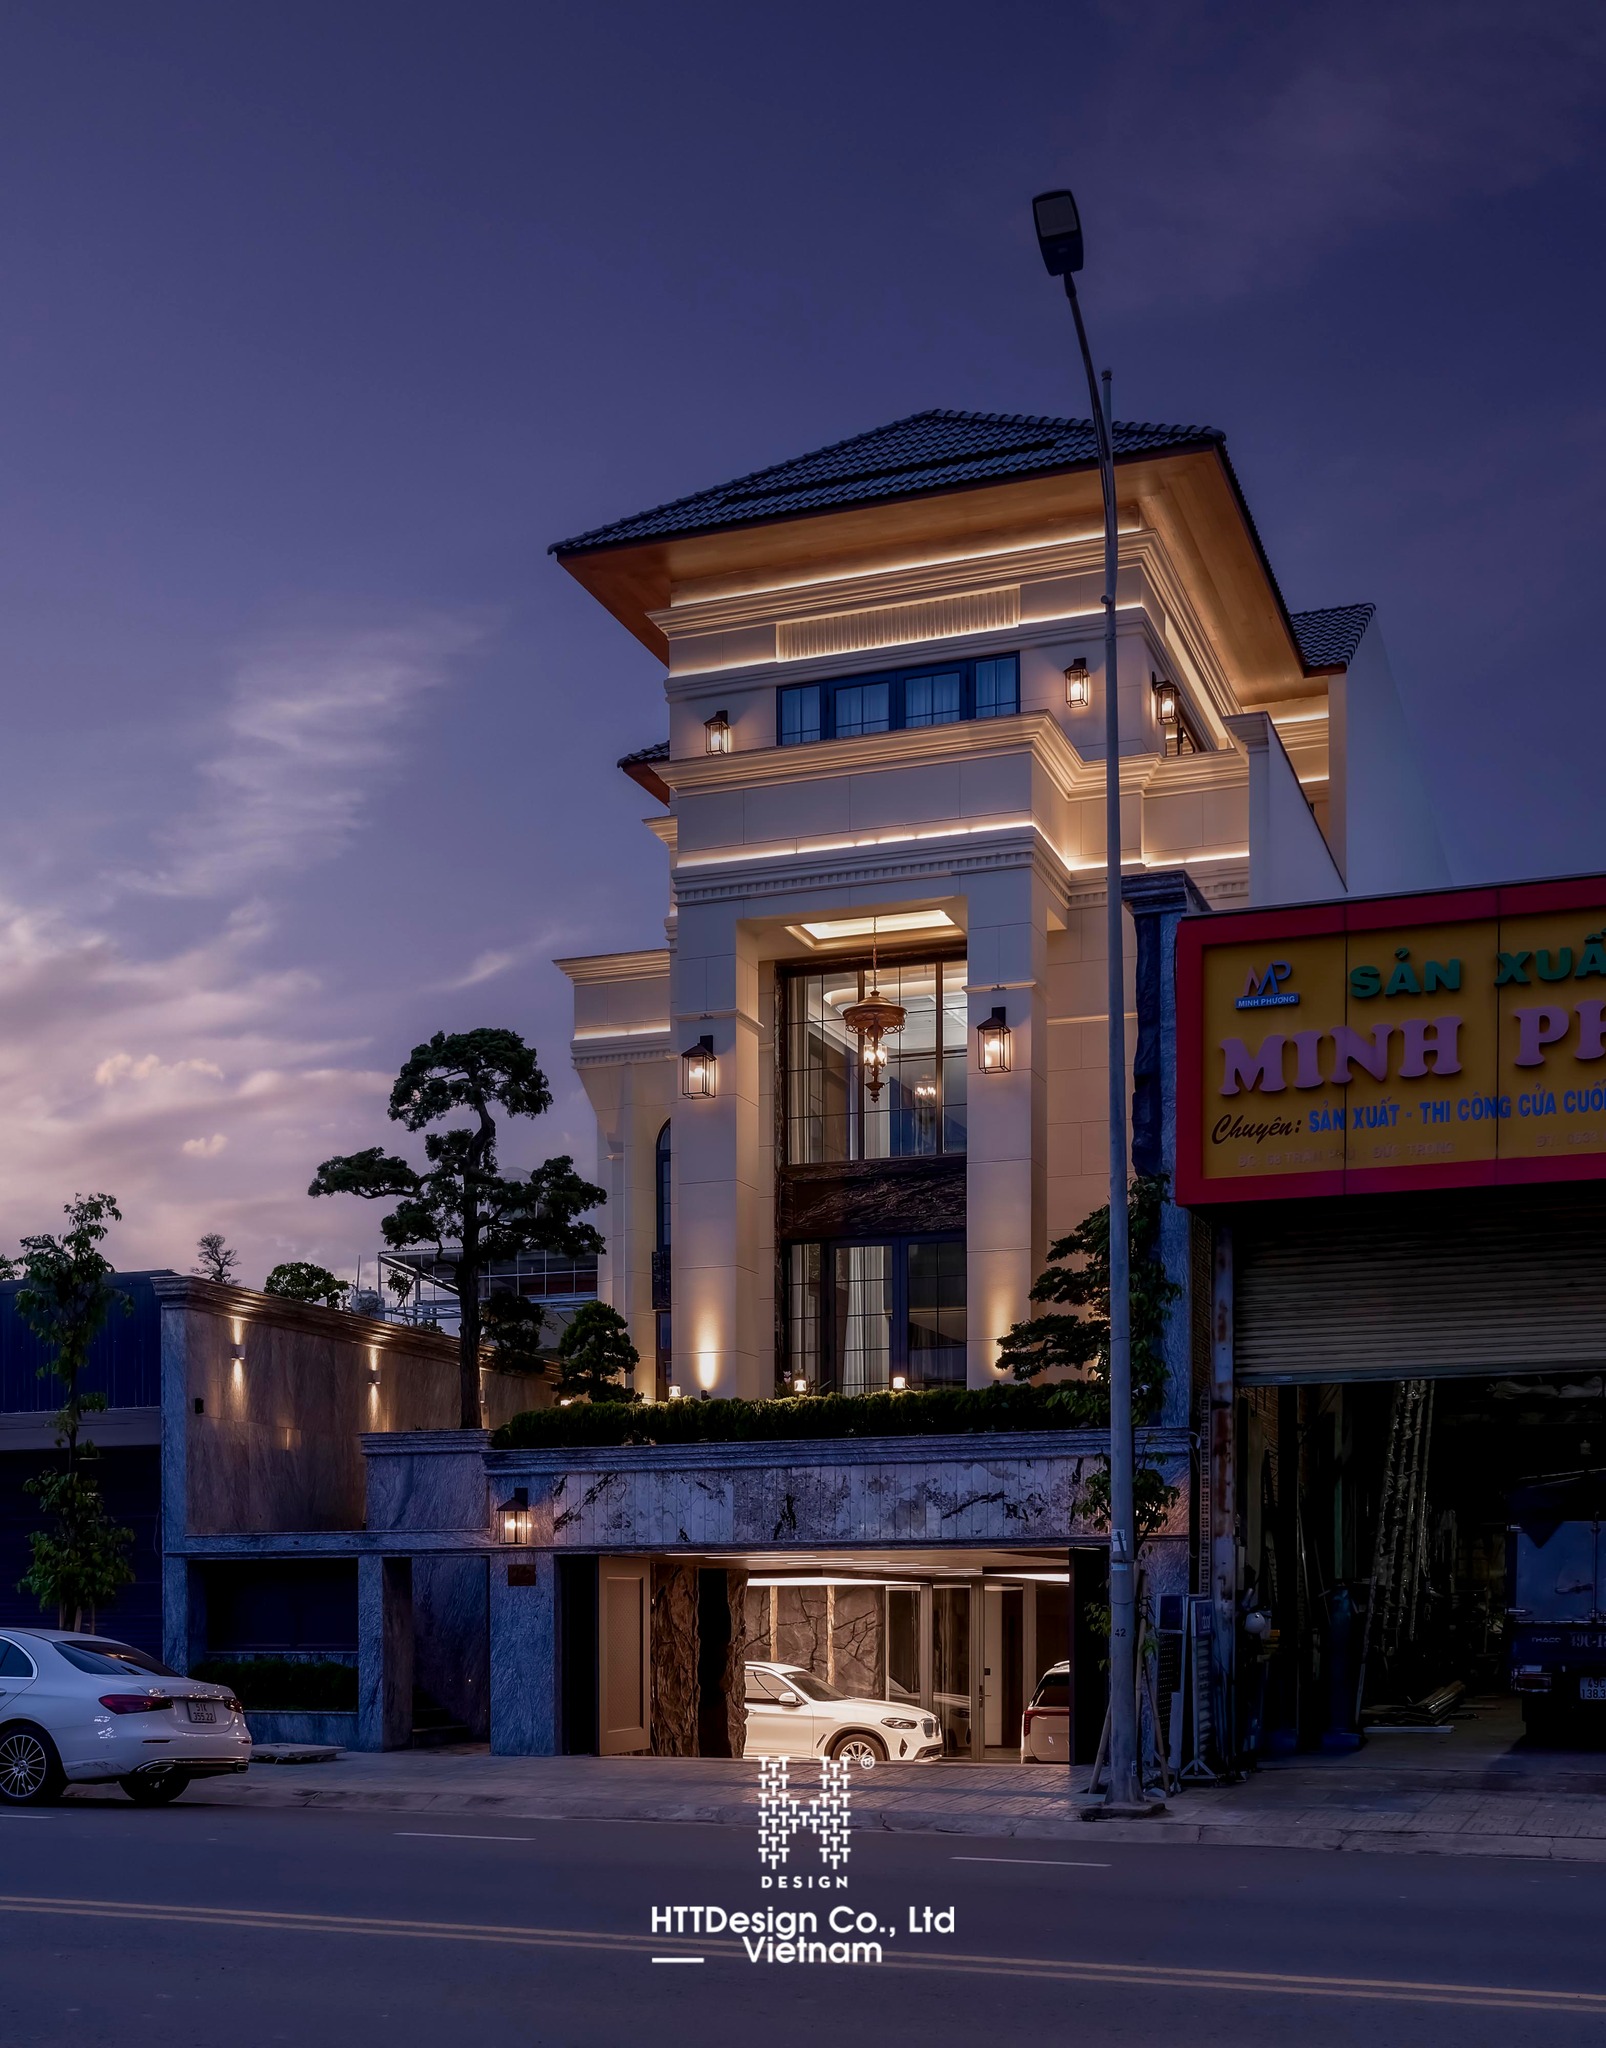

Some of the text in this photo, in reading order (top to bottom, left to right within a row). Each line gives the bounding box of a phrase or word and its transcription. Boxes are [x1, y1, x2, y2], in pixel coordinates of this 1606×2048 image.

[1350, 947, 1461, 998] SẢN
[1238, 995, 1296, 1007] MINH PHƯƠNG
[1219, 1016, 1463, 1096] MINH
[1211, 1113, 1302, 1146] Chuyên:
[1308, 1100, 1345, 1133] SẢN
[1353, 1096, 1400, 1130] XUẤT
[1419, 1101, 1451, 1125] THI
[1457, 1091, 1511, 1122] CÔNG
[1519, 1082, 1557, 1118] CỬA
[1114, 1628, 1126, 1638] 42
[1587, 1678, 1606, 1688] 49C
